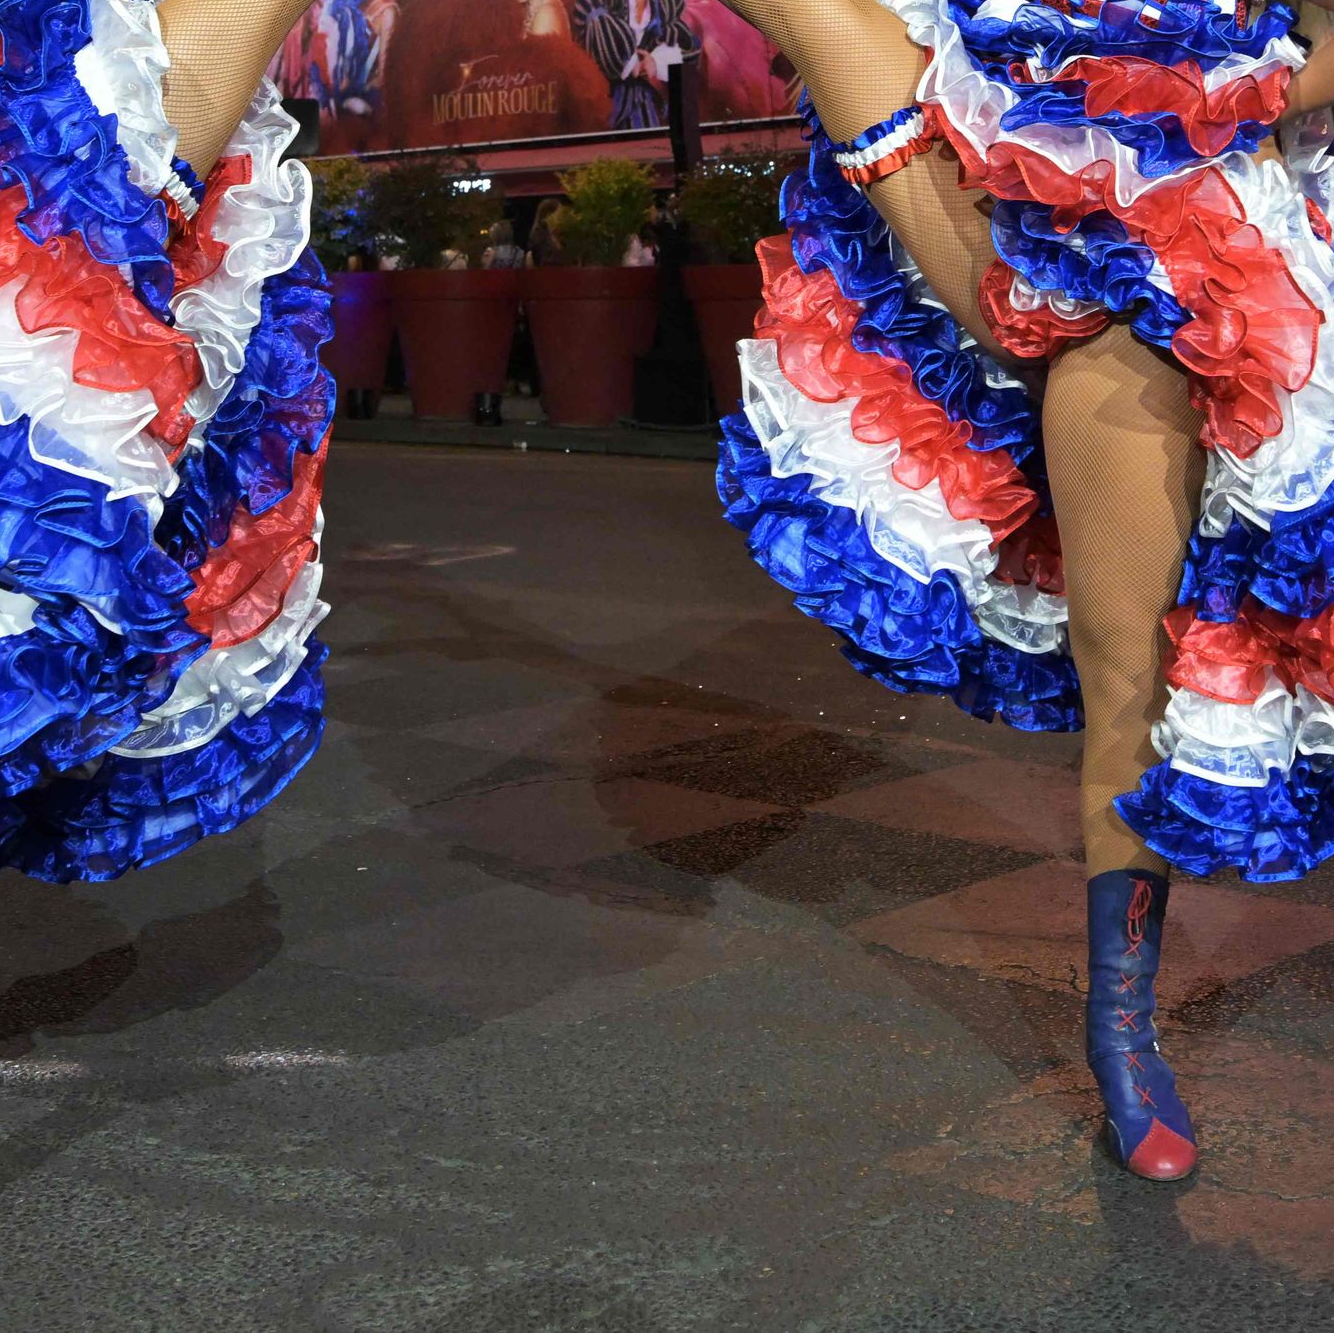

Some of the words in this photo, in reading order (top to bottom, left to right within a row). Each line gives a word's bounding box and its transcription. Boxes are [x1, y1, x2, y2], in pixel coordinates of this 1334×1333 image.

[450, 54, 535, 96] Forever
[432, 89, 494, 125] MOULIN
[498, 80, 558, 115] ROUGE
